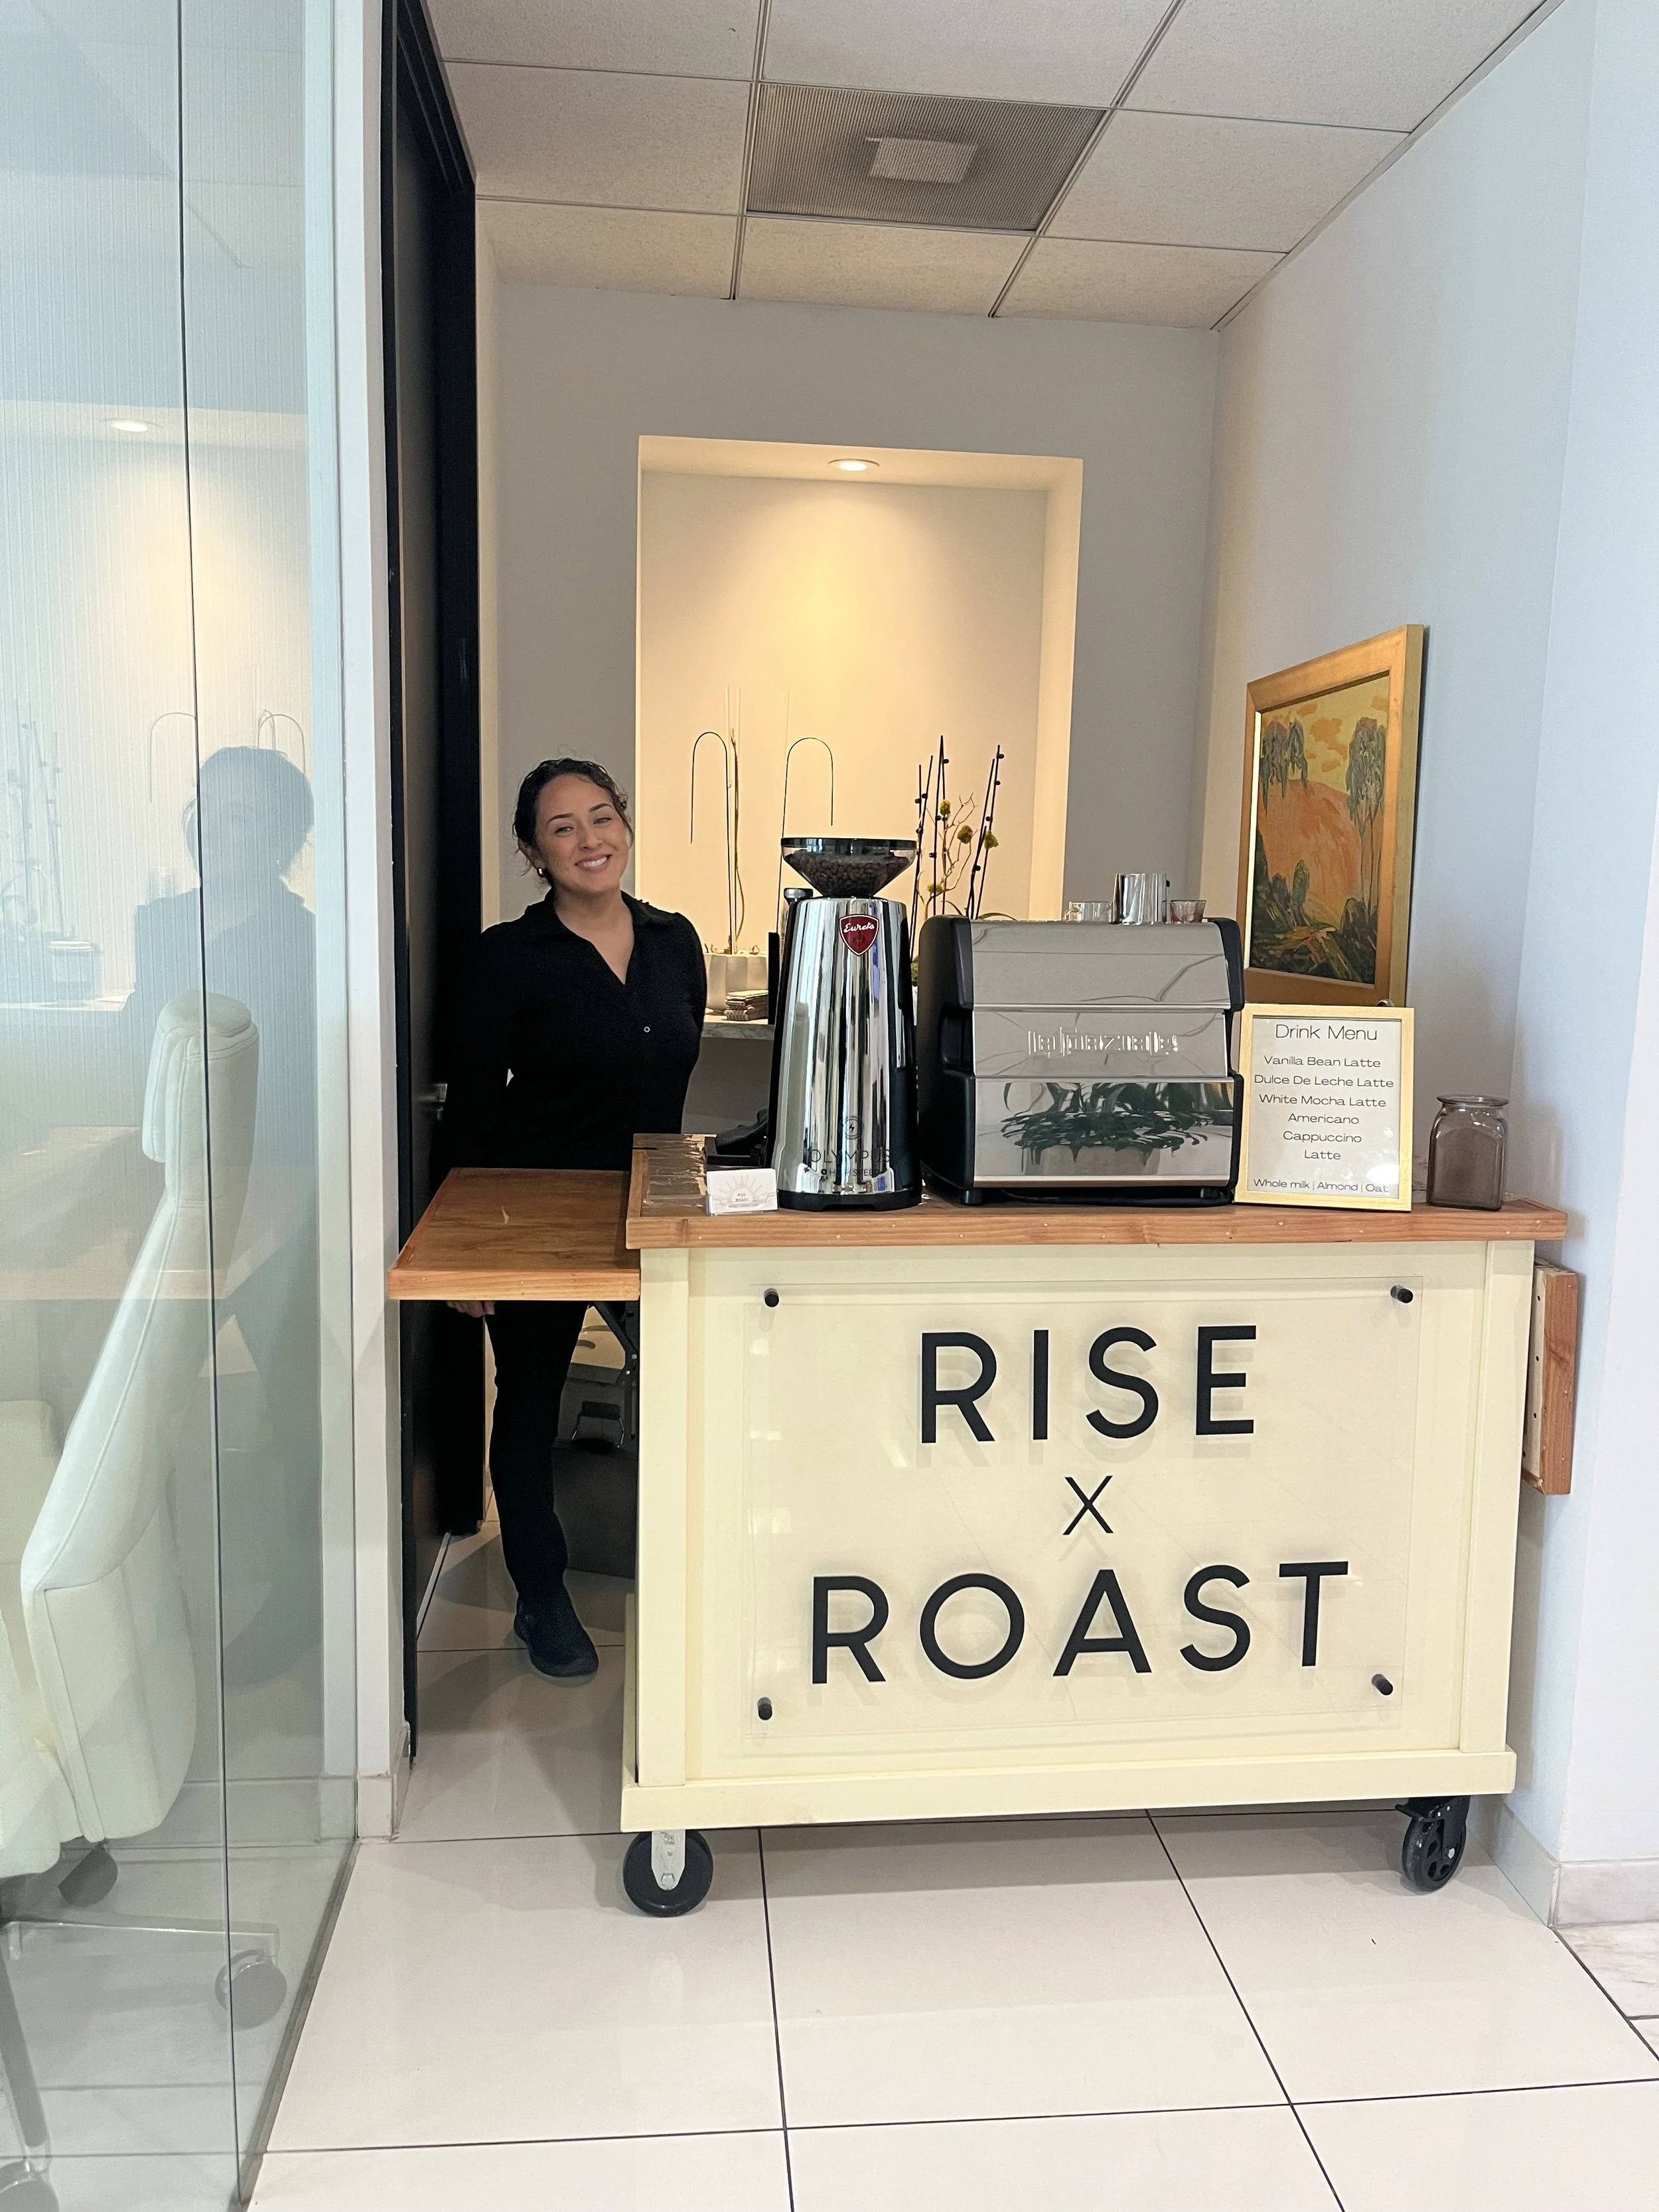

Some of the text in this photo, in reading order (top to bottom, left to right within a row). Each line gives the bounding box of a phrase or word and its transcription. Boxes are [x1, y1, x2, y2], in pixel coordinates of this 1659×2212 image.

[843, 922, 875, 933] Eureka
[1275, 1024, 1378, 1041] Drink Menu
[1263, 1055, 1381, 1068] Vanilla Bean Latte
[1254, 1074, 1394, 1088] Dulce De Leche Latte
[1259, 1094, 1386, 1107] White Mocha Latte
[1288, 1113, 1360, 1124] Americano
[1283, 1131, 1362, 1143] Cappuccino
[808, 1149, 891, 1163] OLYMPUS
[1304, 1149, 1341, 1160] Latte
[1253, 1179, 1287, 1188] Whole
[1290, 1180, 1310, 1189] milk
[1317, 1181, 1358, 1191] Almond
[1365, 1184, 1389, 1193] Oat
[922, 1325, 1256, 1443] RISE
[812, 1562, 1348, 1684] ROAST
